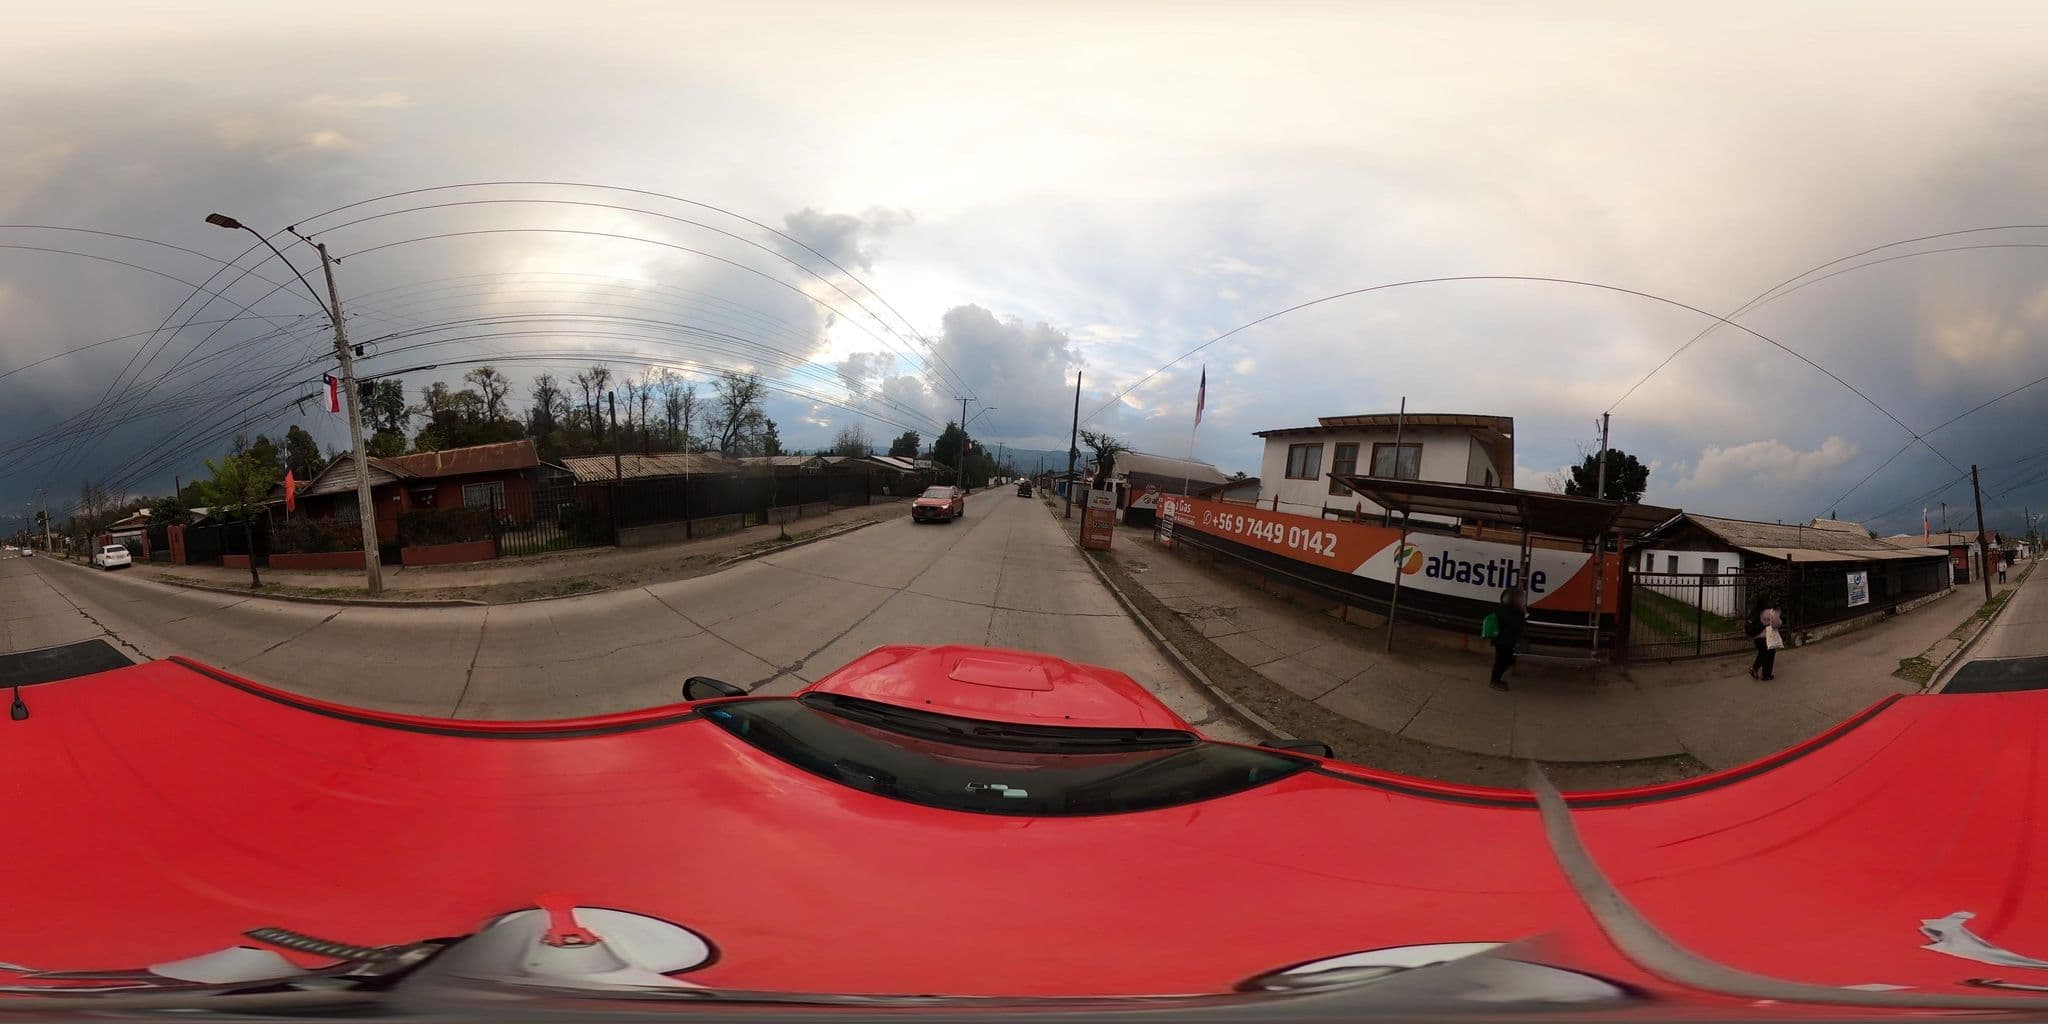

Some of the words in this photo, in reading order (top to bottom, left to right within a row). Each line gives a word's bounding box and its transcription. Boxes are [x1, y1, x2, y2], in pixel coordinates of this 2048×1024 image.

[1179, 499, 1192, 513] Gas
[1212, 512, 1233, 532] +56
[1235, 515, 1244, 534] 9
[1246, 517, 1285, 544] 7449
[1288, 526, 1338, 558] 0142
[1425, 550, 1547, 593] abastibe
